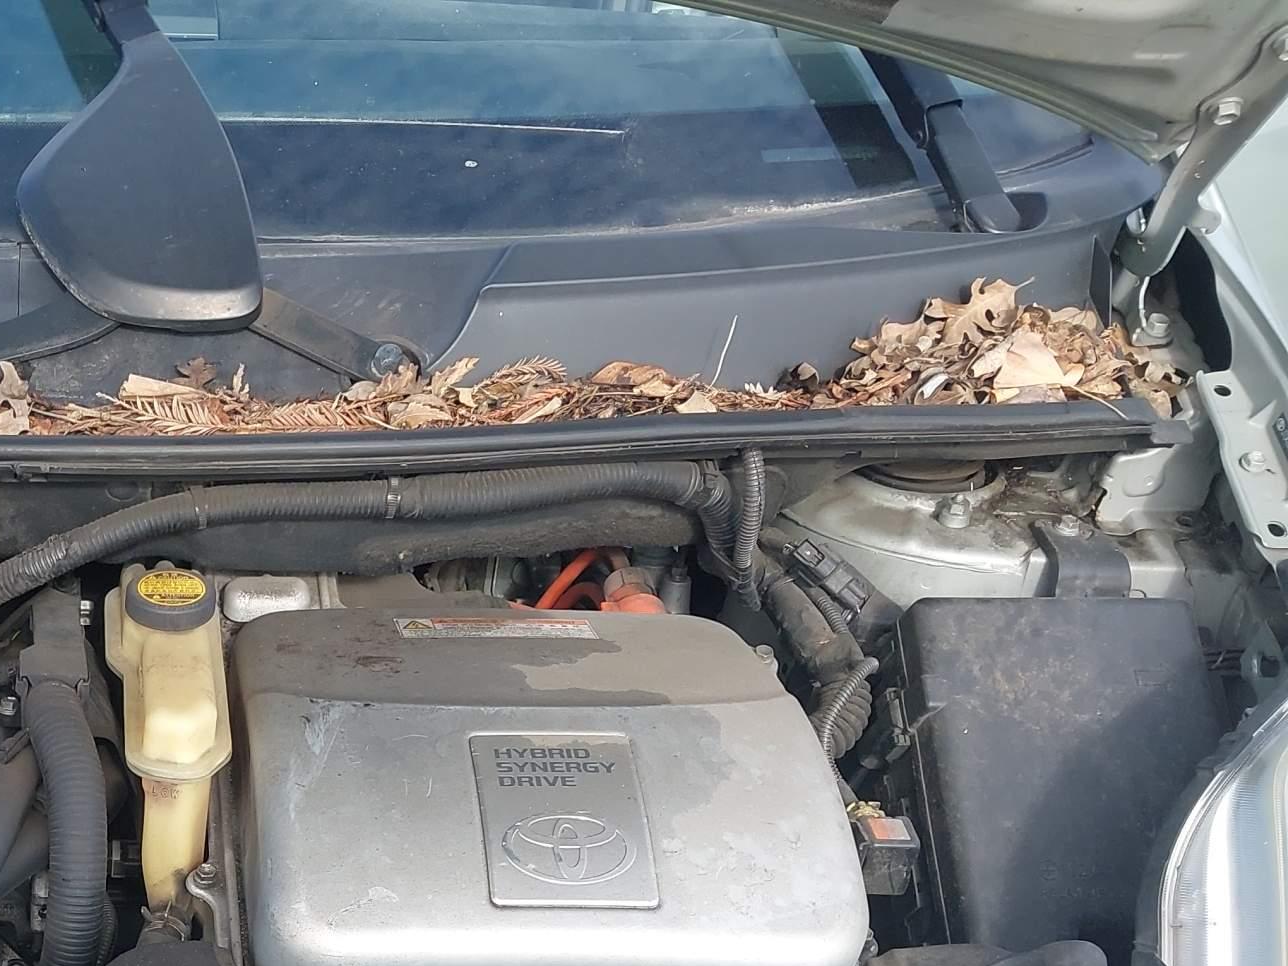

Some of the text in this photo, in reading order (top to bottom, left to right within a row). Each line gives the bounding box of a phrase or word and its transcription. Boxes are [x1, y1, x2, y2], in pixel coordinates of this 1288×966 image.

[494, 748, 591, 759] HYBRID
[495, 762, 616, 773] SYNERGY
[498, 776, 577, 787] DRIVE
